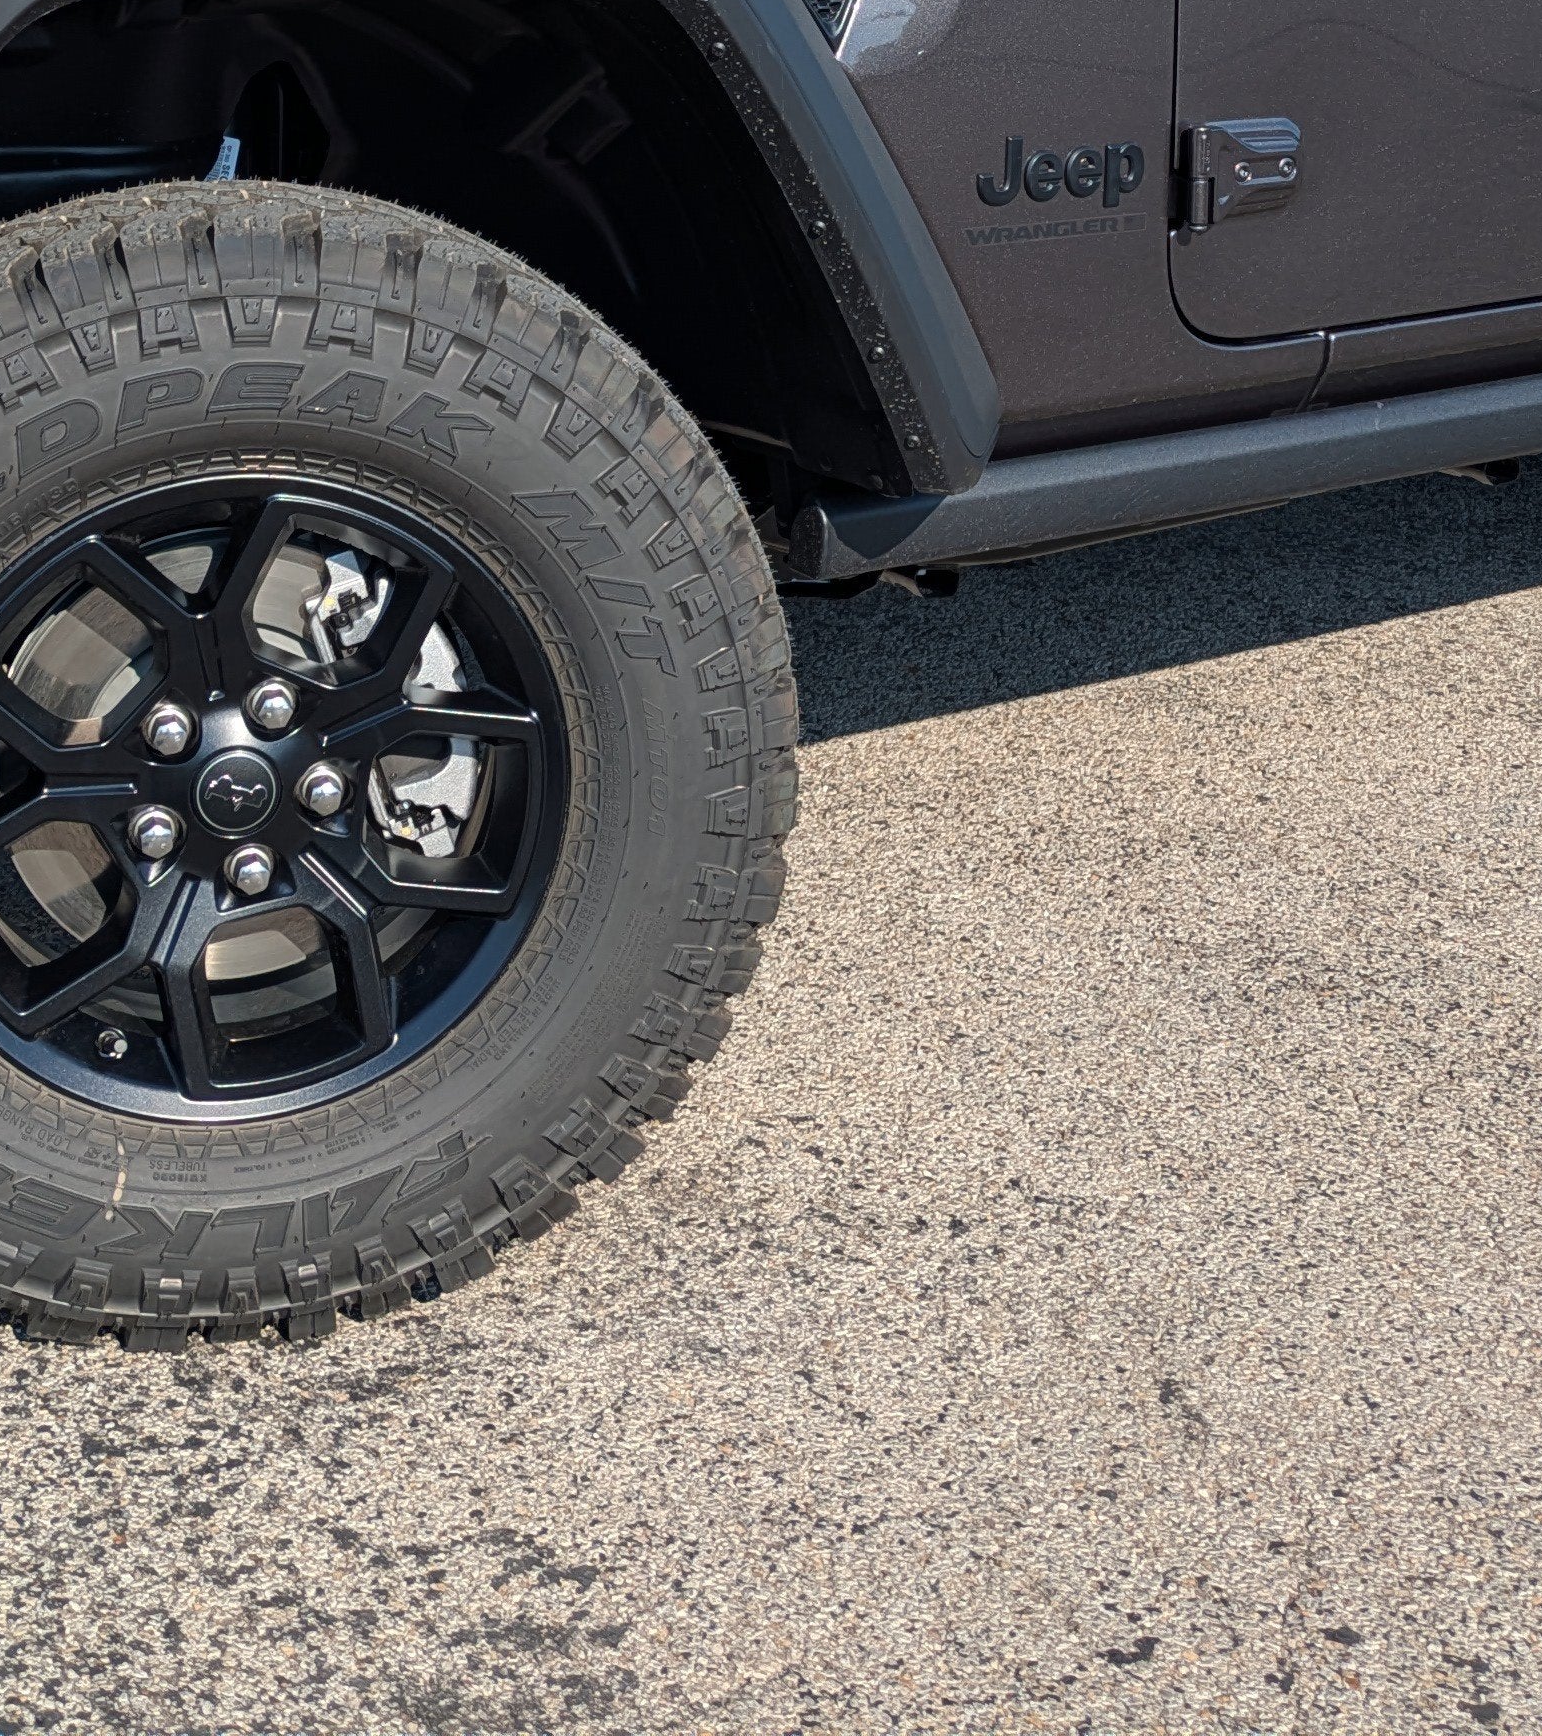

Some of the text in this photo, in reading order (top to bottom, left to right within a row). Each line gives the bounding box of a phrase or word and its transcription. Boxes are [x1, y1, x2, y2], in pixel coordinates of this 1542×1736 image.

[976, 135, 1145, 208] Jeep
[964, 217, 1120, 246] WRANGLER
[148, 1159, 206, 1171] TUBELESS
